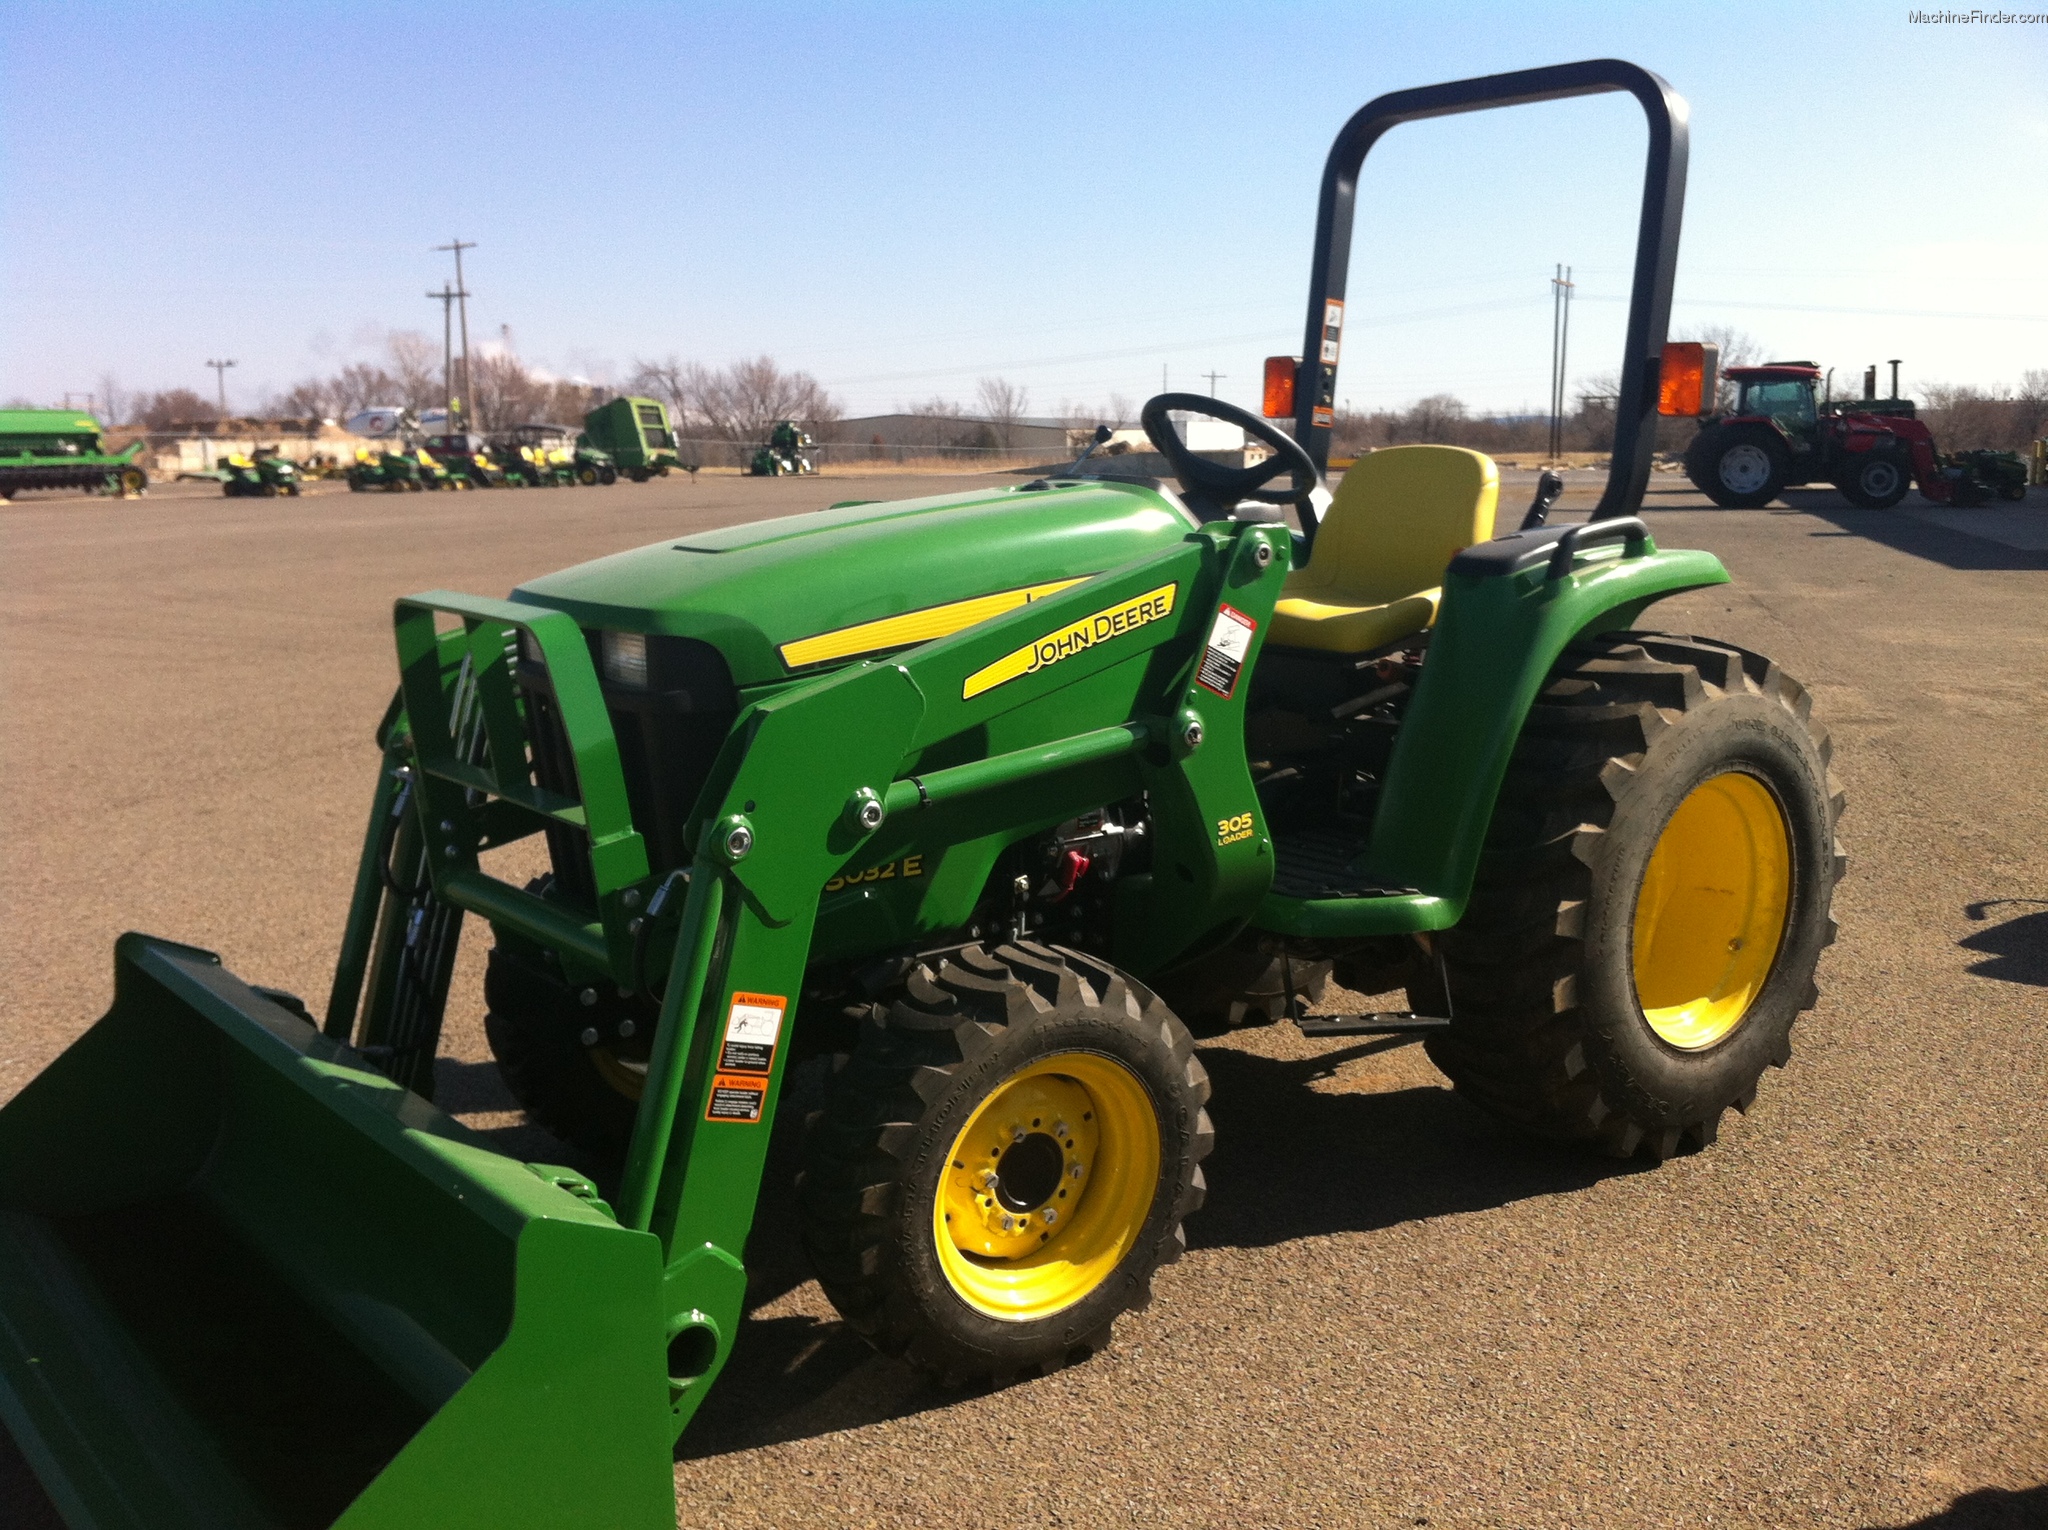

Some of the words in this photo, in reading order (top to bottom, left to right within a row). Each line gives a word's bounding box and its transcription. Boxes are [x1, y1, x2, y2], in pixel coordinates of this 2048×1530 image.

[1027, 627, 1090, 671] JOHN
[1094, 595, 1167, 640] DEERE
[1217, 812, 1253, 836] 305
[1217, 828, 1254, 846] LOADER
[747, 996, 780, 1007] WARNING
[728, 1079, 762, 1089] WARNING
